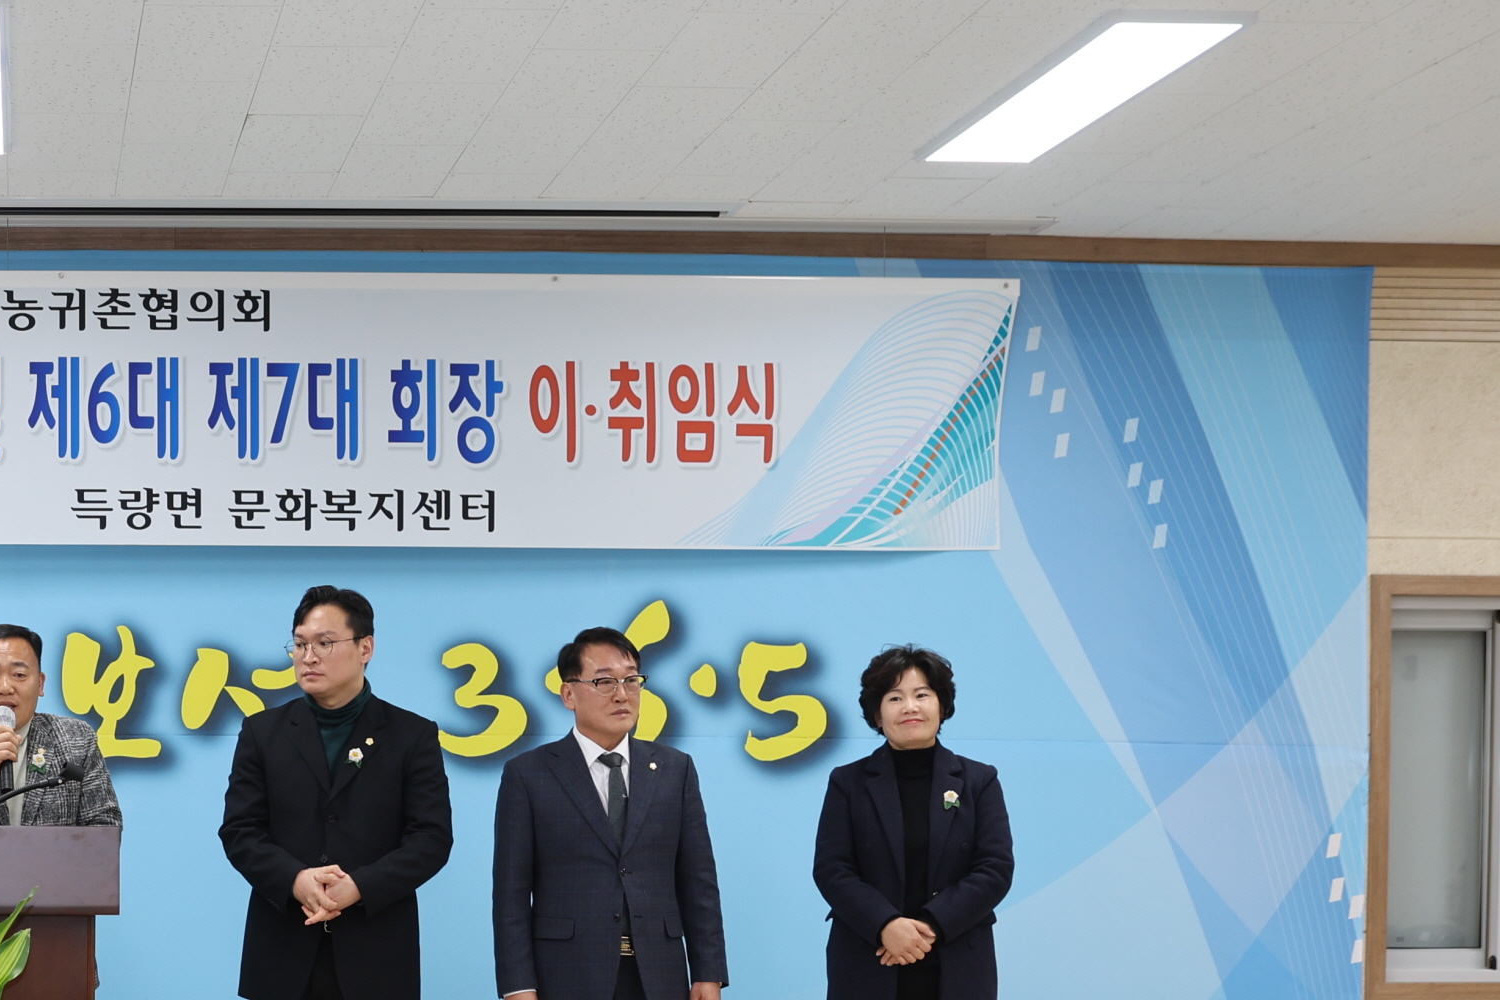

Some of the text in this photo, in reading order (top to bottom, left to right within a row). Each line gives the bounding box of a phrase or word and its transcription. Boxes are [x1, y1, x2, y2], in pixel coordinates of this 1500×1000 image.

[27, 355, 179, 461] 제6대
[207, 356, 359, 462] 제7대
[388, 357, 505, 464] 회장
[529, 361, 778, 464] 이·취임식
[70, 487, 497, 533] 득량면 문화복지센터
